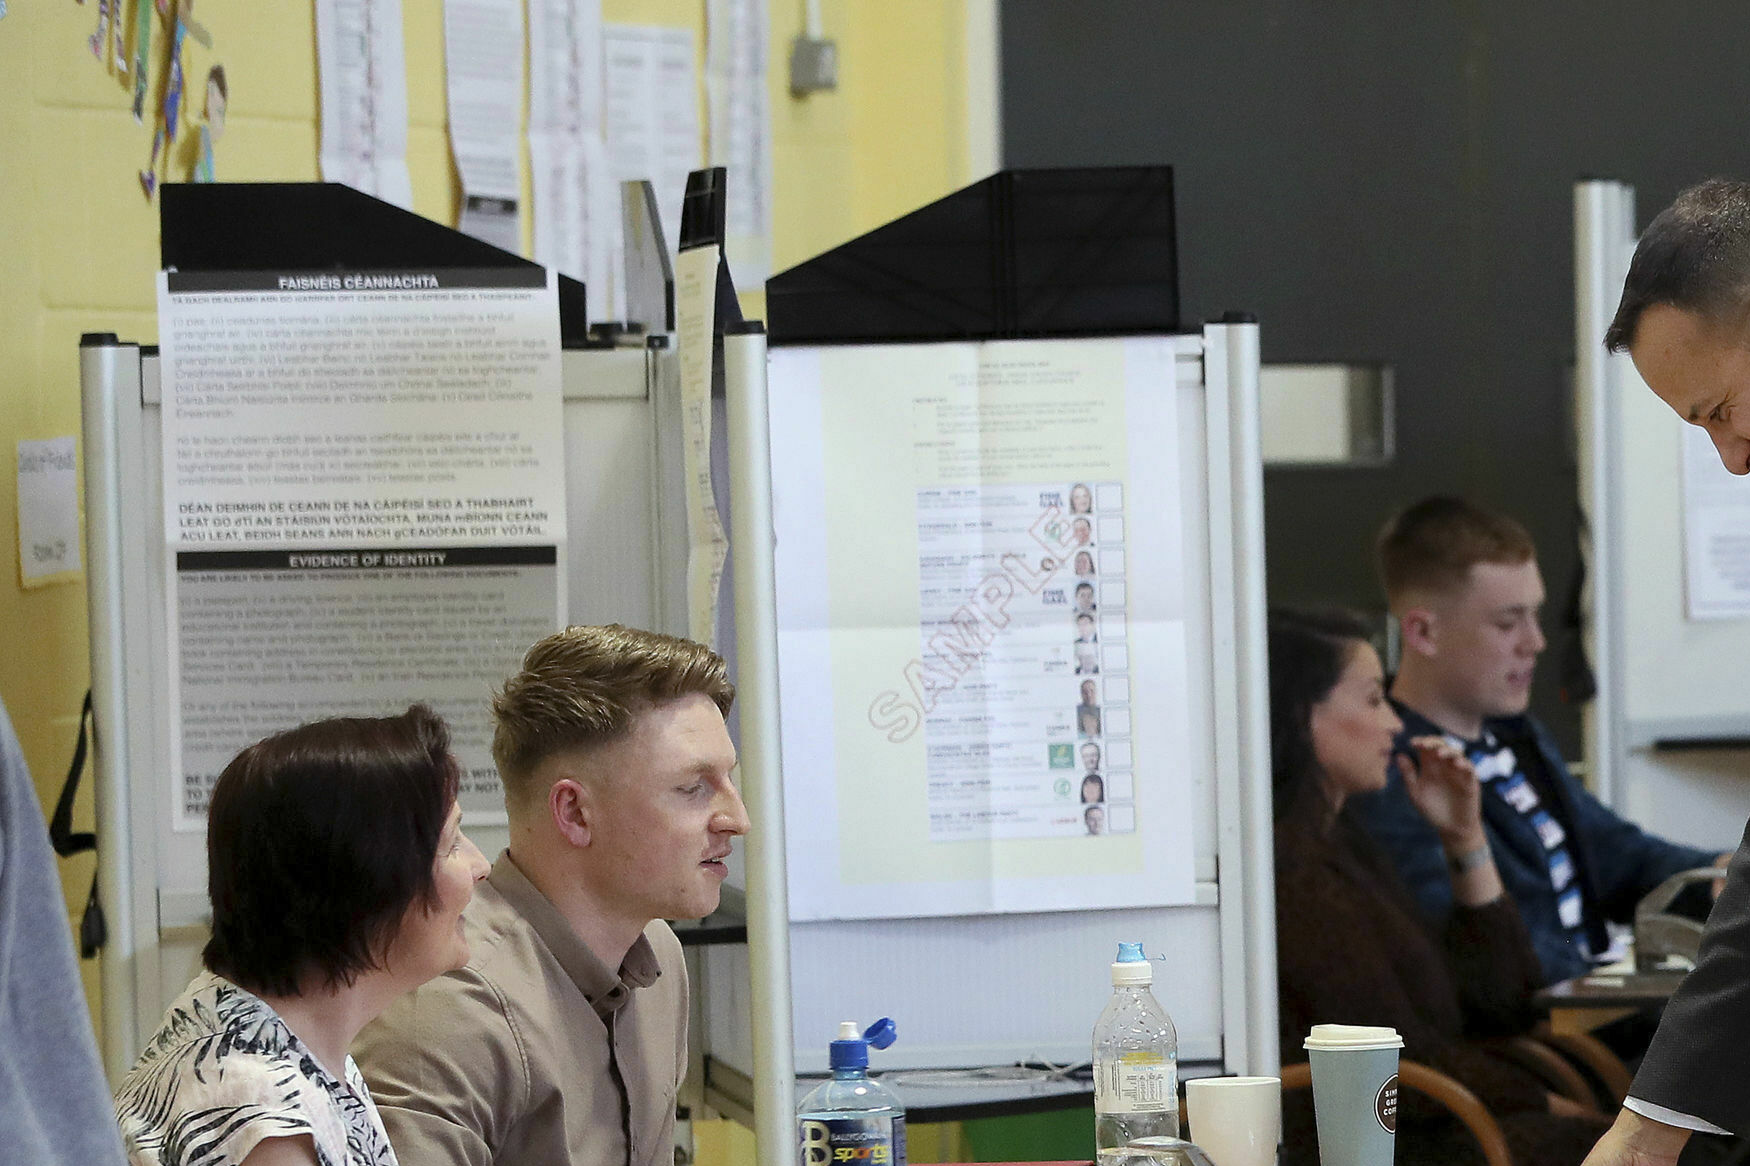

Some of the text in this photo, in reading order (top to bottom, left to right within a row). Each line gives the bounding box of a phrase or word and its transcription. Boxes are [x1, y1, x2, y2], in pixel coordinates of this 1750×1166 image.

[289, 552, 447, 568] EVIDENCE OF IDENTITY
[867, 505, 1083, 746] SAMPLE
